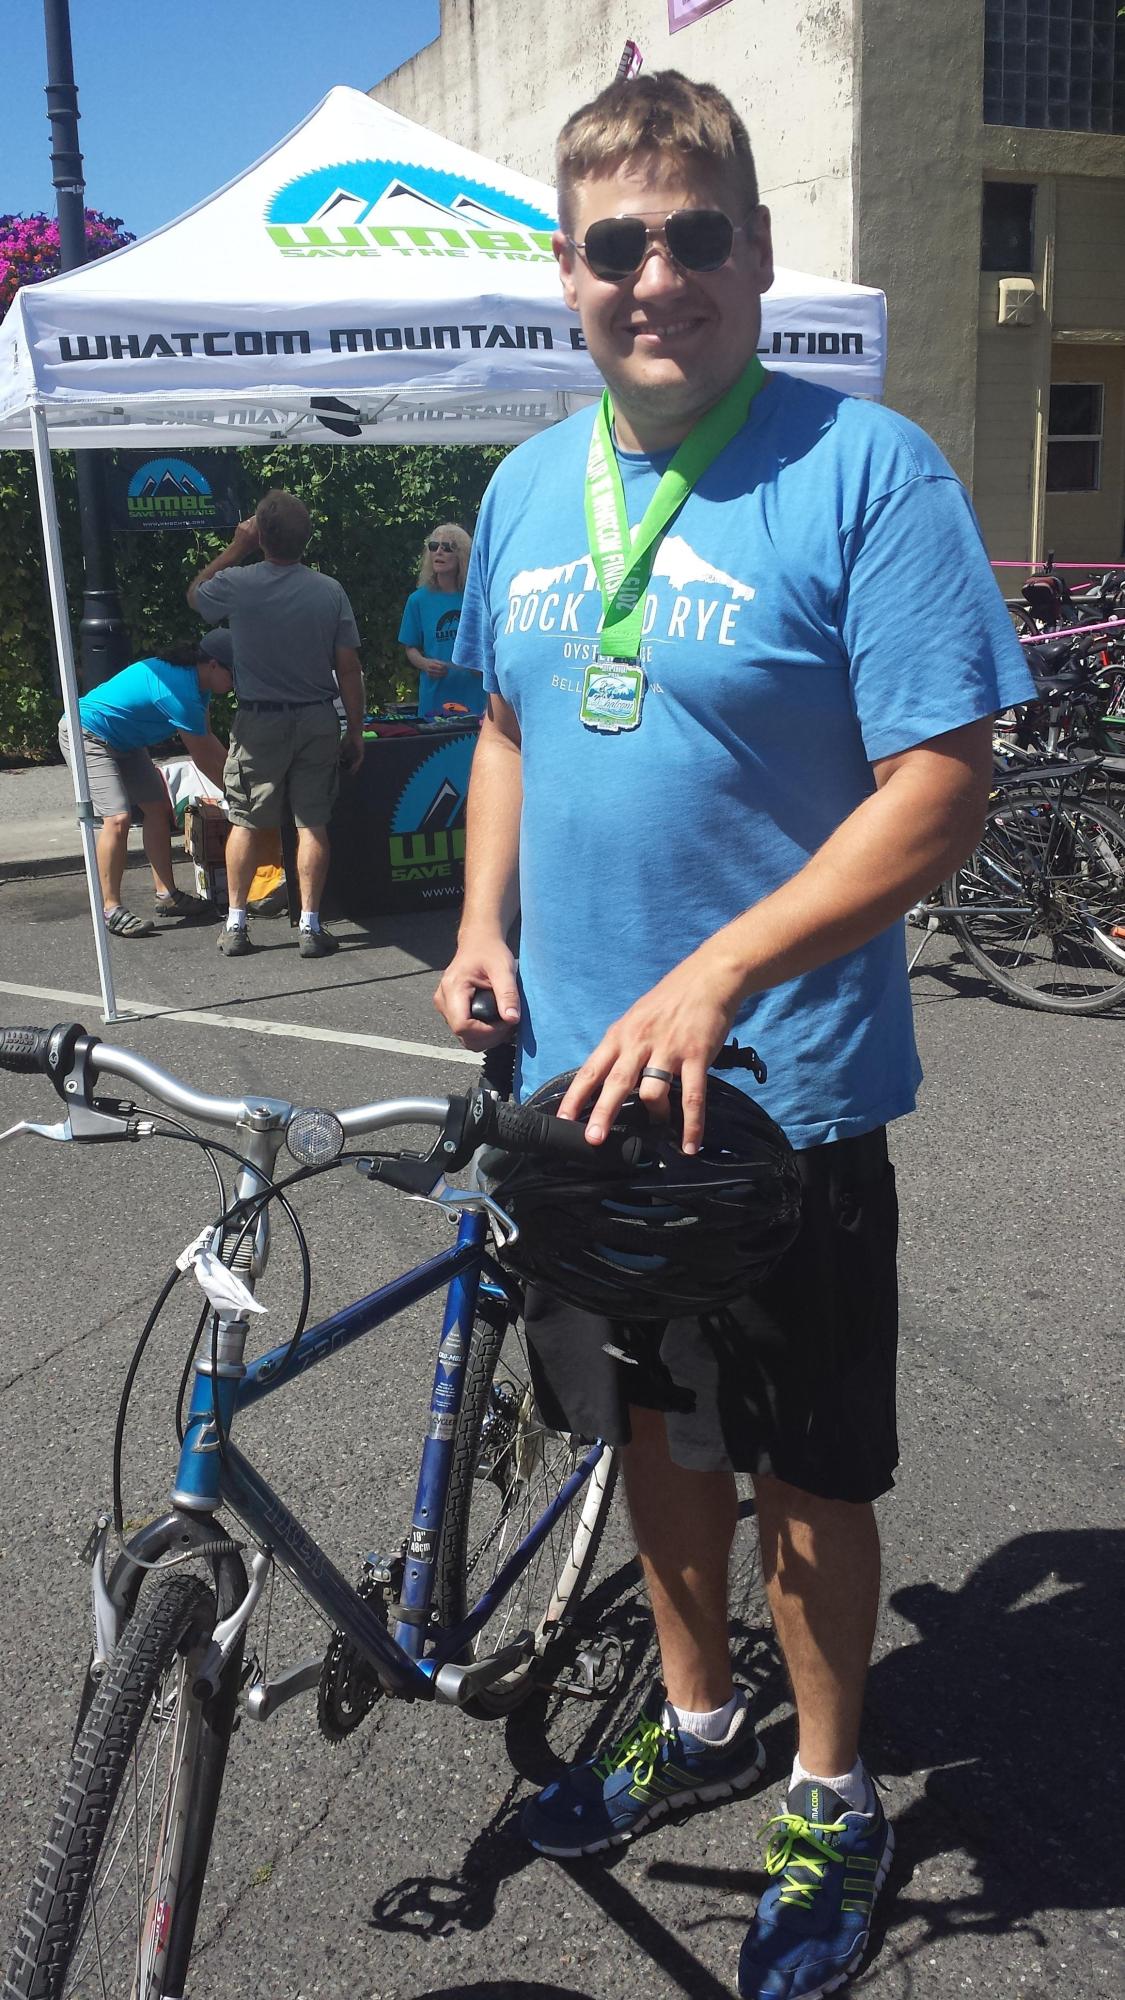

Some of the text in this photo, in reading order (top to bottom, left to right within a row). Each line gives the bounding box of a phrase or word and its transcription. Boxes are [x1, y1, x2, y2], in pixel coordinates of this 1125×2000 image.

[280, 248, 557, 263] SAVE THE TRA
[58, 330, 311, 361] WHATCOM
[329, 325, 553, 353] MOUNTAIN
[127, 495, 216, 511] WMBC
[504, 592, 585, 635] ROCK
[667, 597, 741, 646] RYE
[391, 863, 452, 882] SAVE
[410, 1541, 431, 1553] 48cm
[811, 1788, 819, 1819] MACOOL
